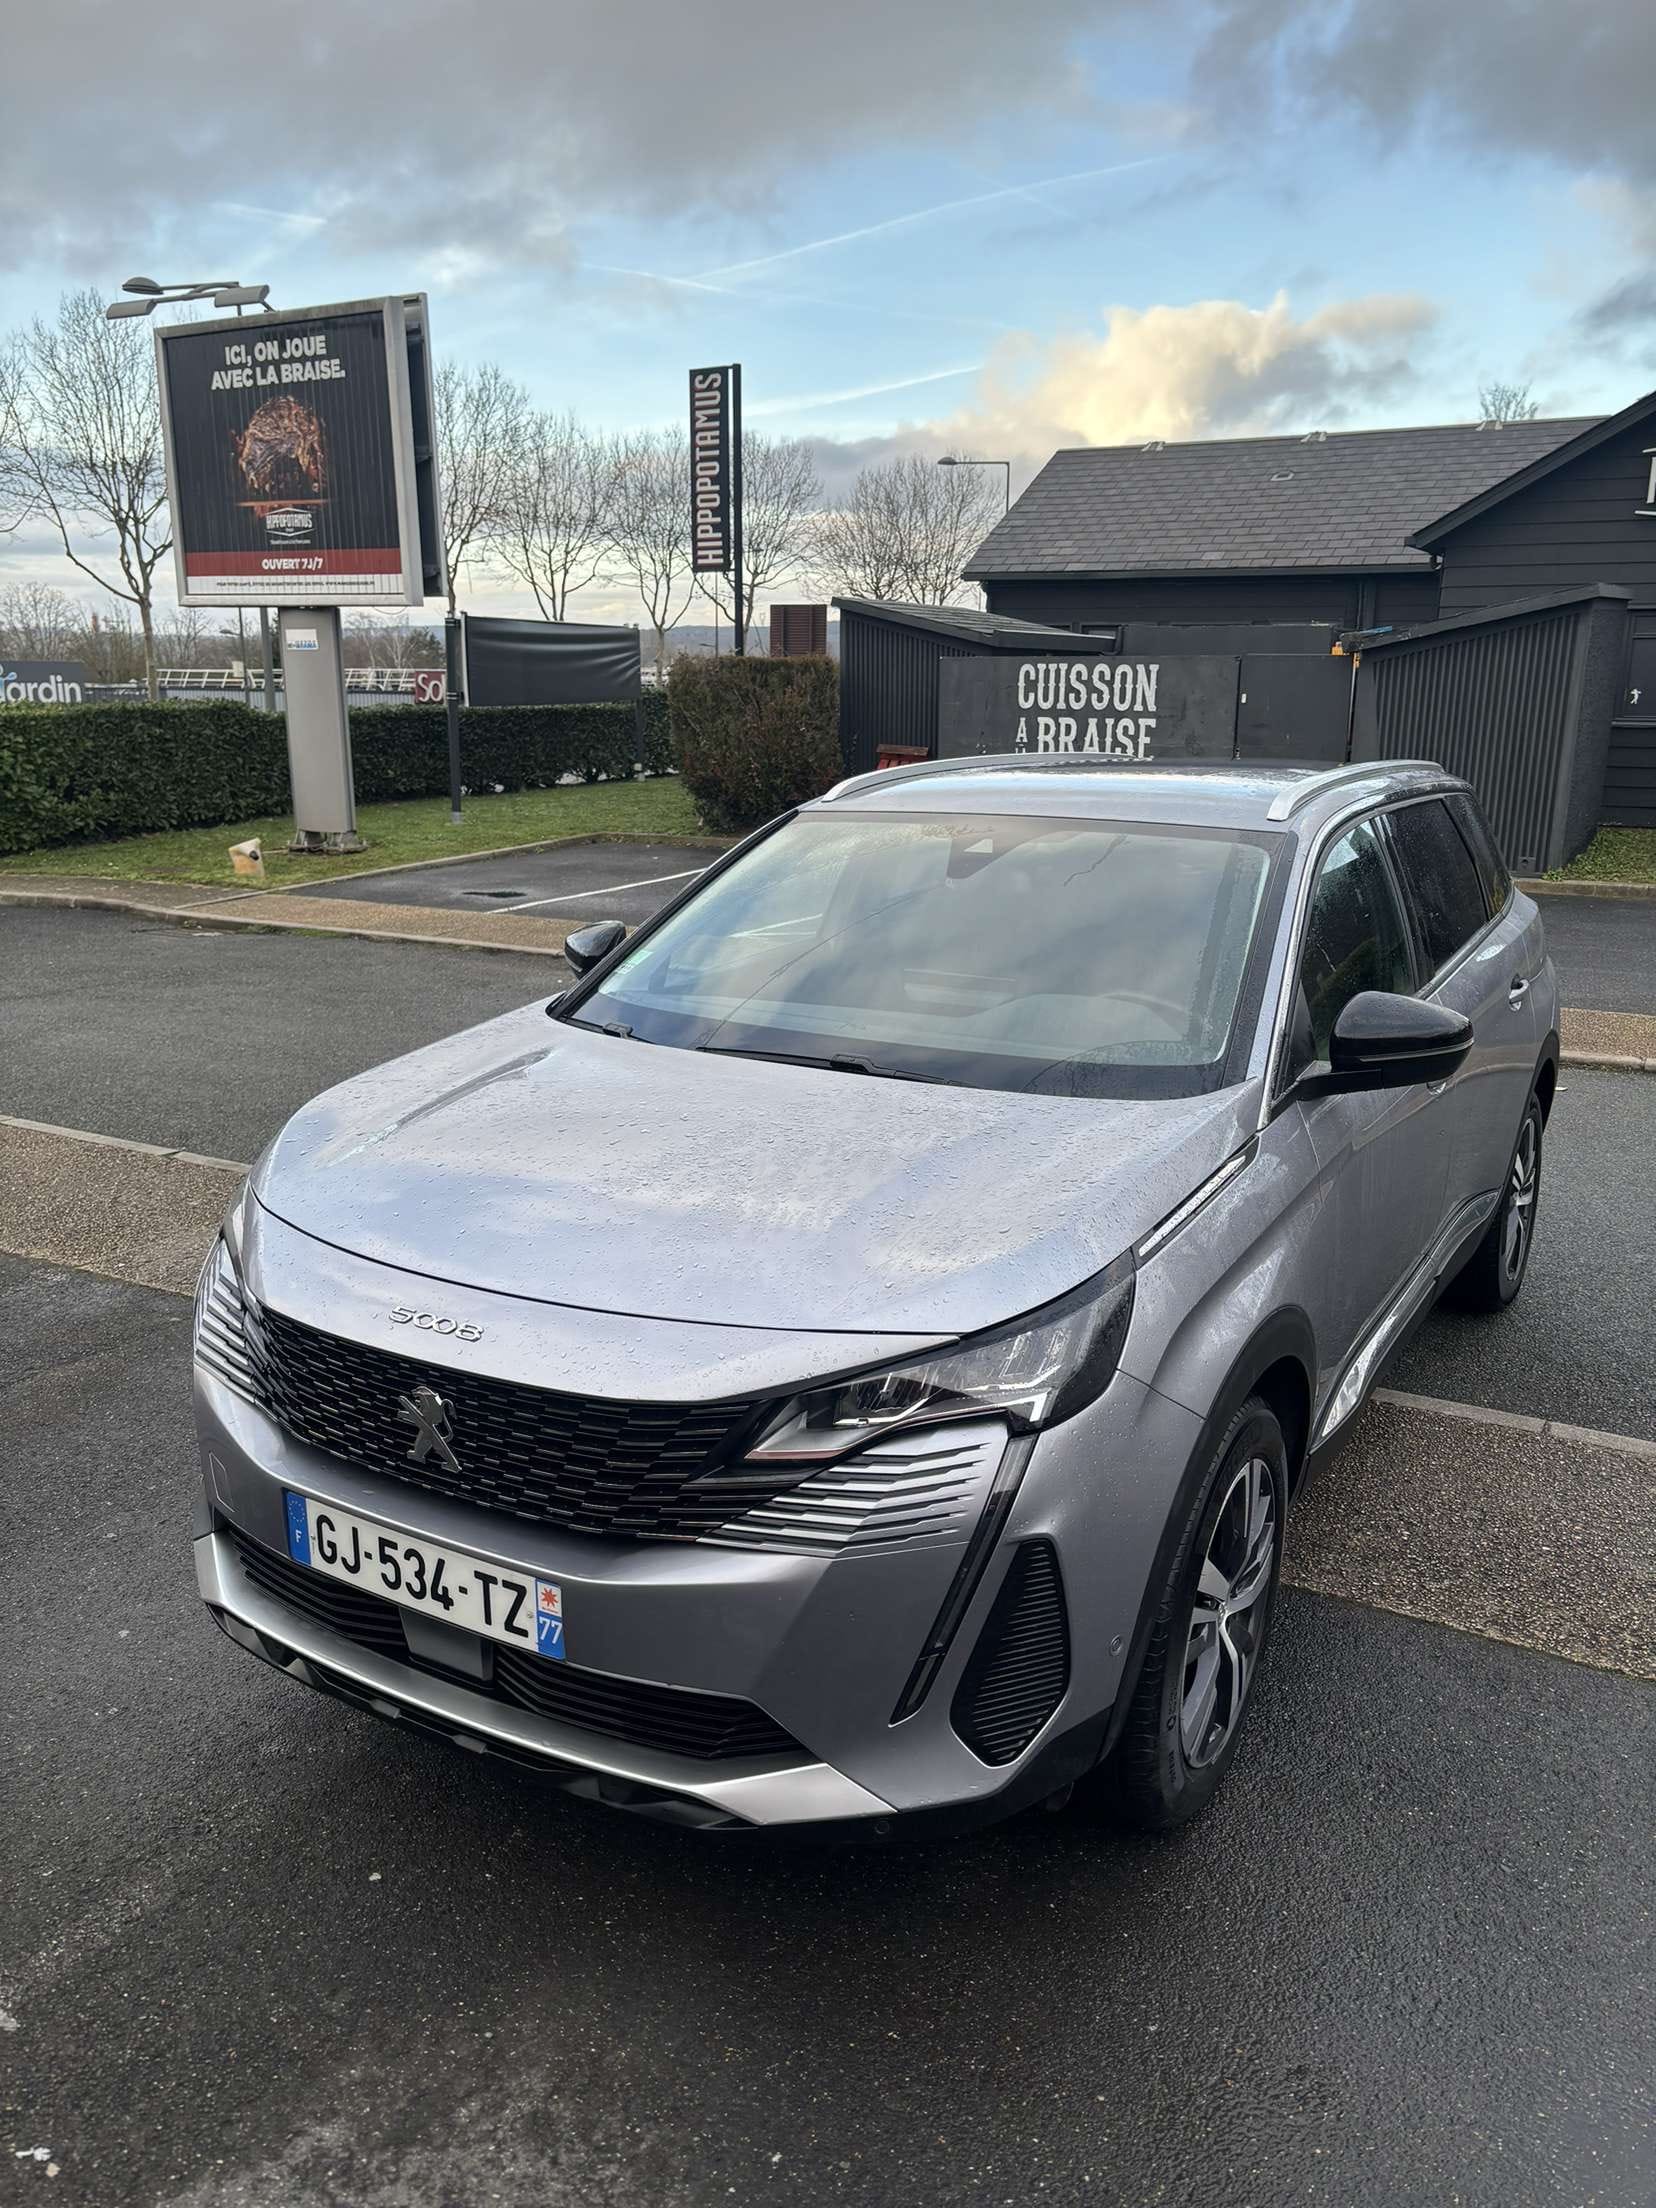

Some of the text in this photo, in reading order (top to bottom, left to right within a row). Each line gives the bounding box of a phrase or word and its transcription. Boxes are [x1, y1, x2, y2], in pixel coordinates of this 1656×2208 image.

[225, 335, 326, 367] ICI, ON JOUE
[211, 359, 346, 390] AVEC LA BRAISE.
[695, 373, 723, 565] HIPPOPOTAMUS
[261, 558, 300, 570] OUVERT
[1018, 663, 1159, 712] CUISSON
[1037, 716, 1157, 758] BRAISE
[389, 1306, 485, 1342] 5008
[295, 1529, 302, 1543] F
[316, 1514, 529, 1638] GJ-534-TZ
[539, 1615, 563, 1645] 77
